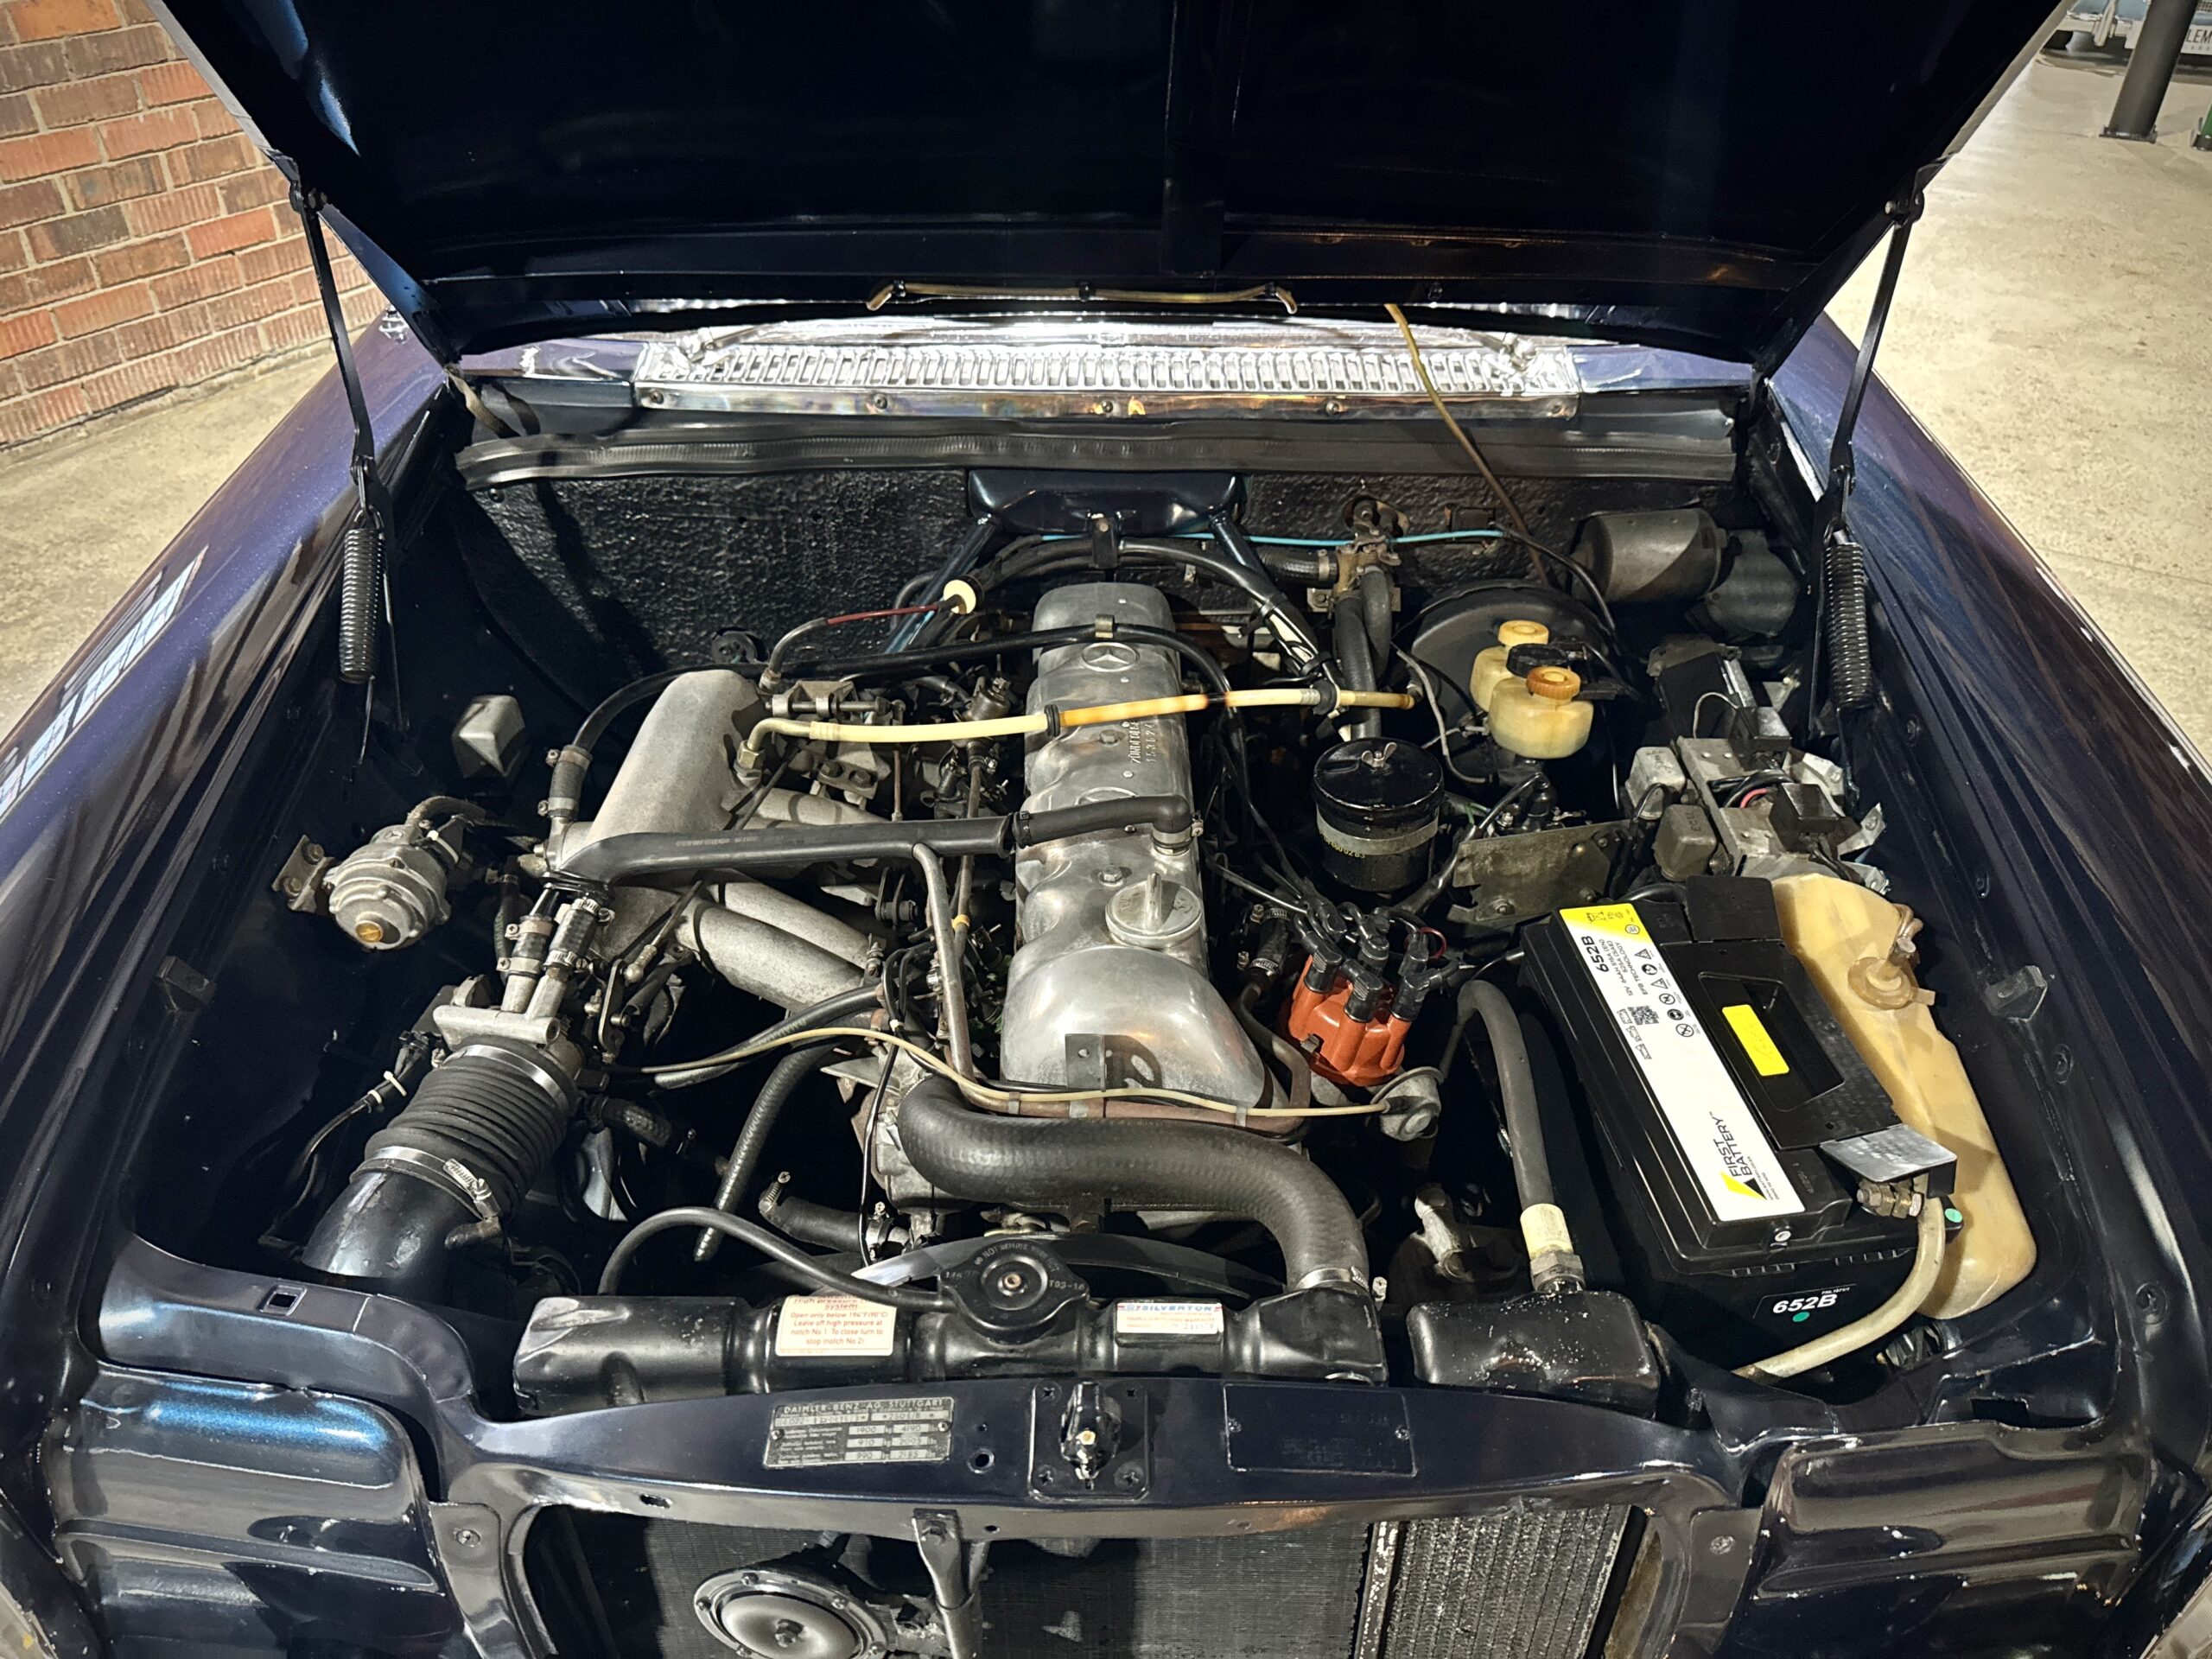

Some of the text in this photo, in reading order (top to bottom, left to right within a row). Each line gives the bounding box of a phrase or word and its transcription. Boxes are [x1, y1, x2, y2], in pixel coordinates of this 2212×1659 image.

[1581, 936, 1609, 972] 652B
[1615, 941, 1641, 982] TECHNOLOGY
[1713, 1139, 1742, 1177] FIRST
[1772, 1294, 1838, 1313] 652B
[889, 1399, 944, 1408] STUTTGART
